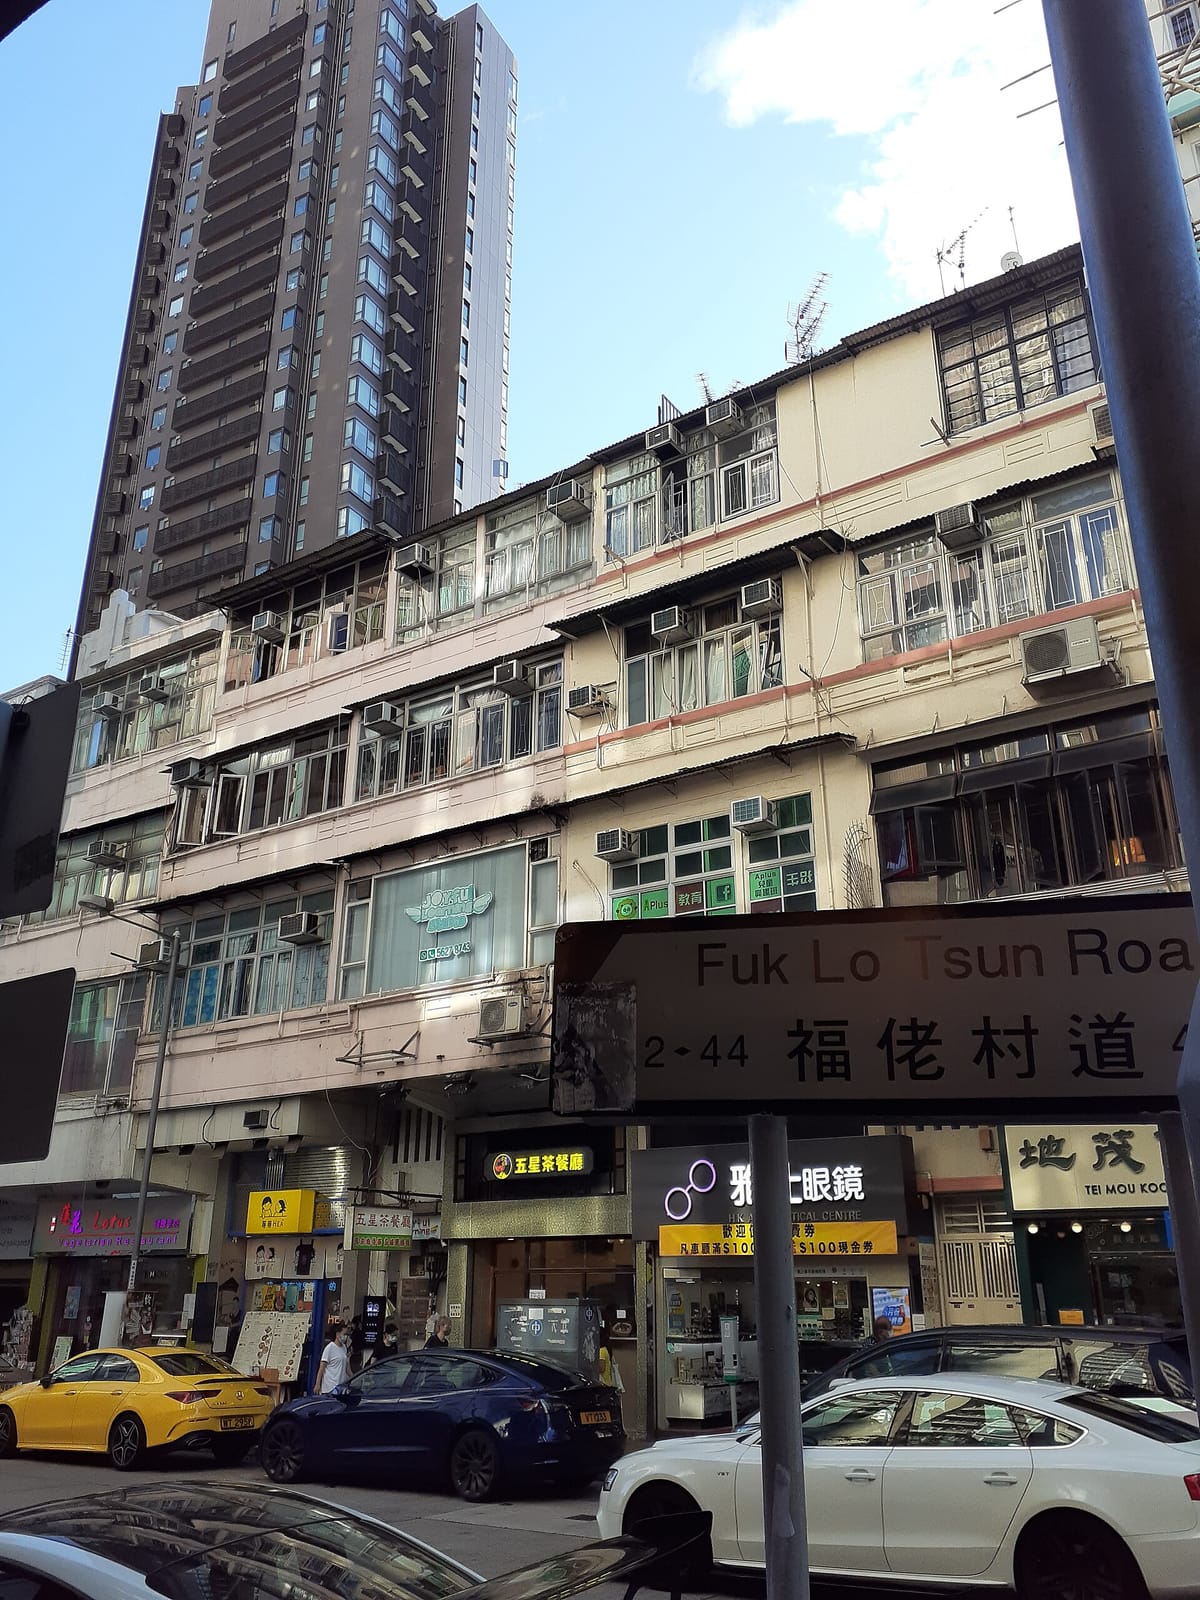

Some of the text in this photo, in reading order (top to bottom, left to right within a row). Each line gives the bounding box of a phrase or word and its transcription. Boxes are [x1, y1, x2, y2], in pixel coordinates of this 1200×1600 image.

[679, 891, 702, 906] 教育
[698, 928, 1195, 986] Fuk Lo Tsun Roa
[700, 1033, 749, 1068] 44
[787, 1011, 1144, 1083] 福佬村道
[514, 1153, 583, 1174] 五星茶餐廳
[1085, 1184, 1102, 1196] TEI
[1106, 1183, 1136, 1195] MOU
[92, 1211, 131, 1230] Lotus
[355, 1213, 411, 1229] 五星茶餐廳
[822, 1211, 862, 1221] CENTRE
